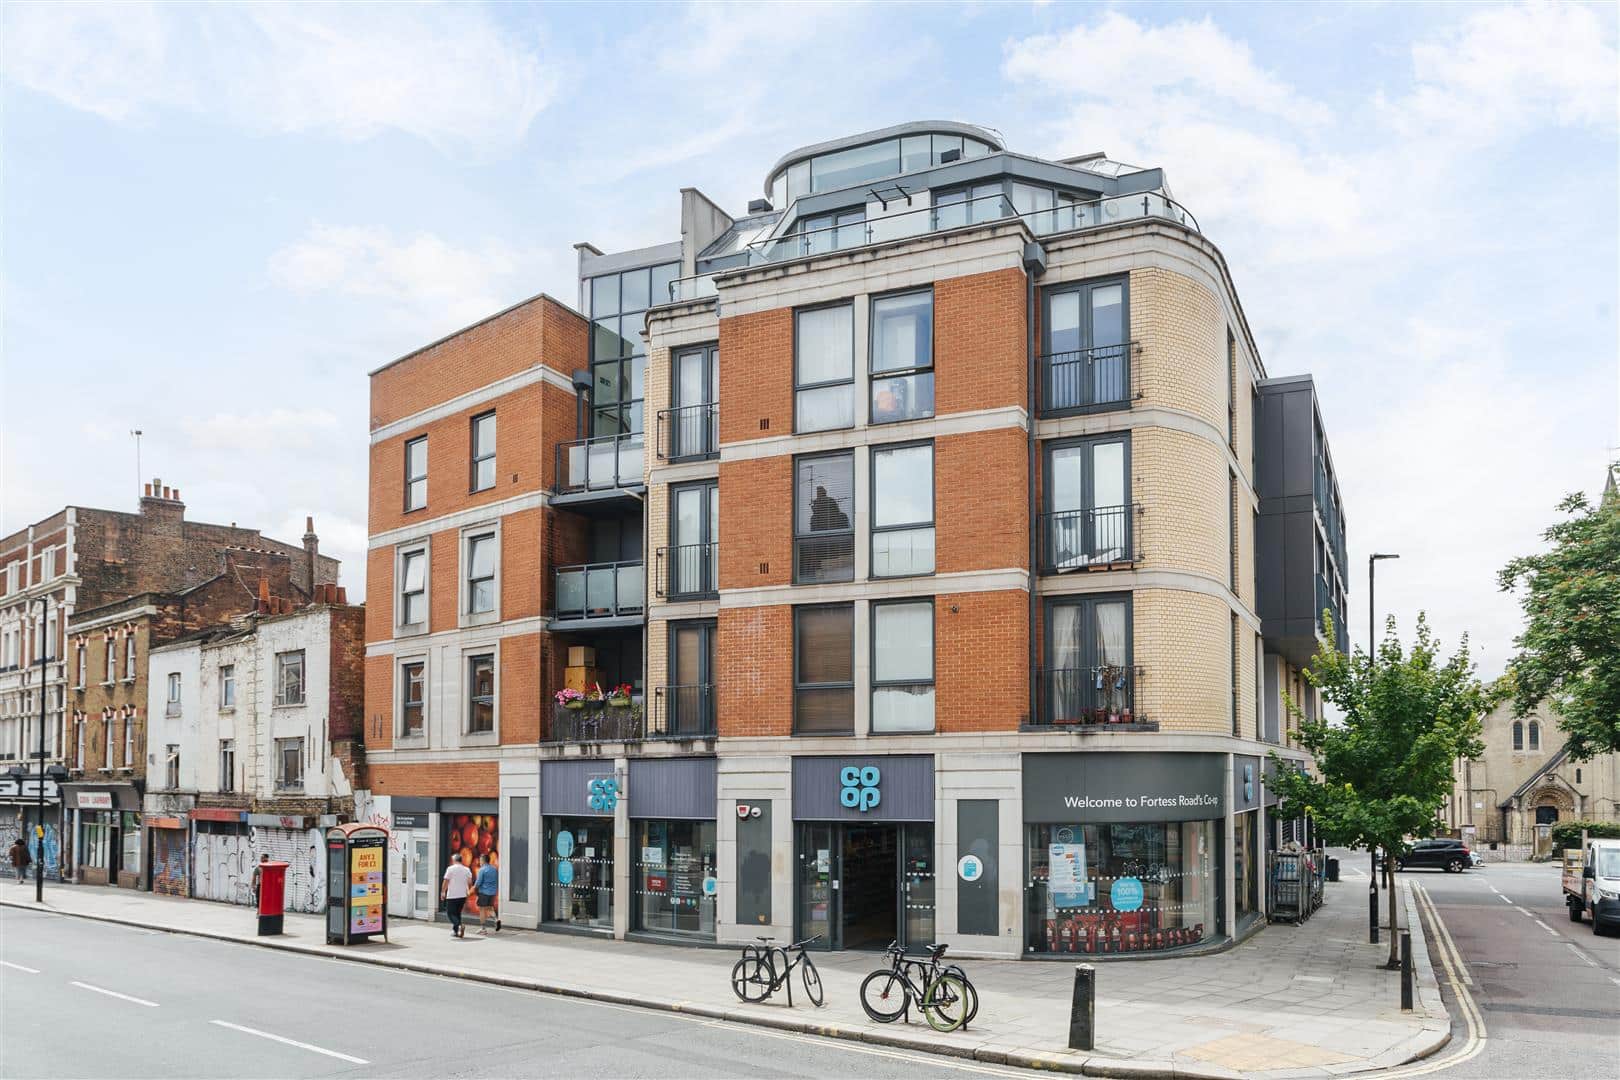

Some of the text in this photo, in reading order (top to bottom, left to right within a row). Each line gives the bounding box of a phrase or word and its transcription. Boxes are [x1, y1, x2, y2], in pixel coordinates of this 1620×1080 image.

[1064, 796, 1123, 808] Welcome
[1125, 797, 1138, 807] to
[1140, 796, 1177, 807] Fortess
[1178, 794, 1203, 806] Road's
